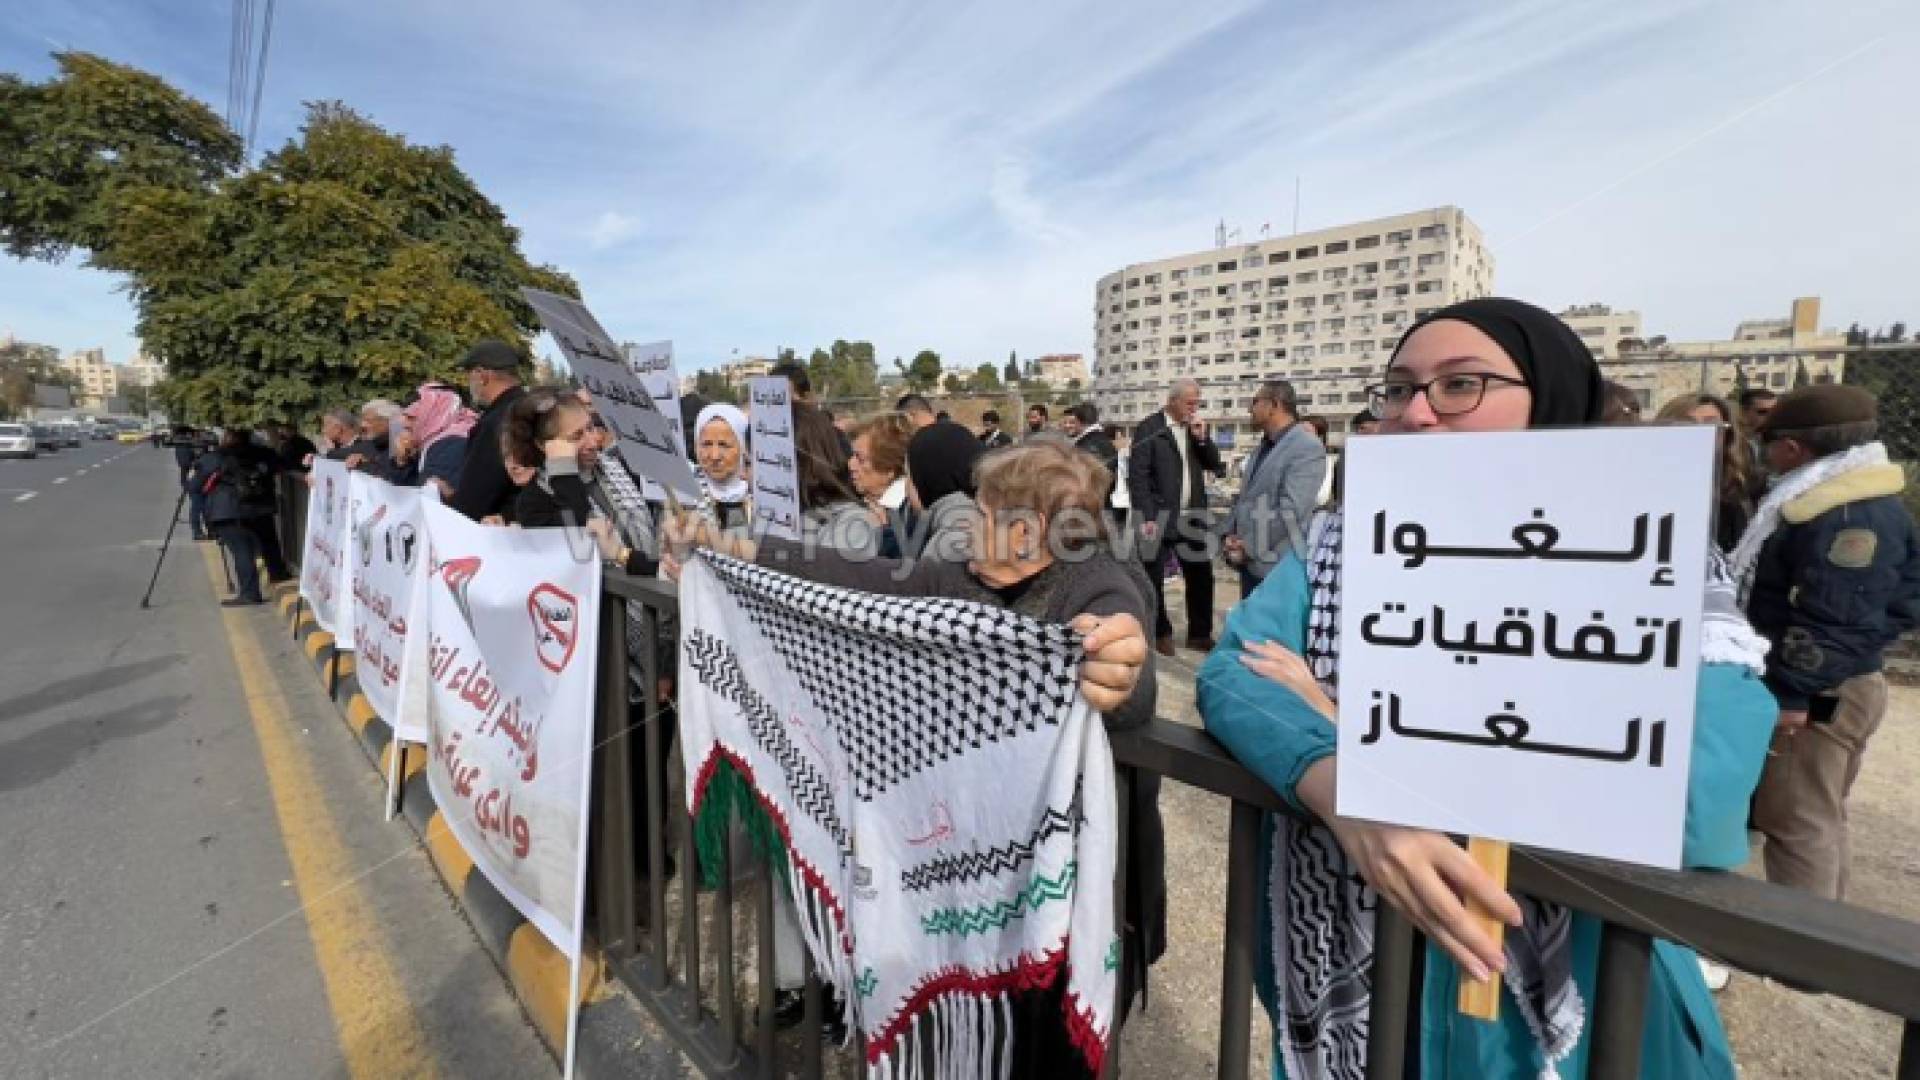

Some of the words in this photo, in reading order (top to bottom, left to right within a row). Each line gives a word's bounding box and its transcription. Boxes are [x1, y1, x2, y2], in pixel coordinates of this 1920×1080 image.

[1372, 506, 1676, 588] إلغوا
[1359, 600, 1683, 670] اتفاقيات
[1359, 689, 1668, 769] الغاز
